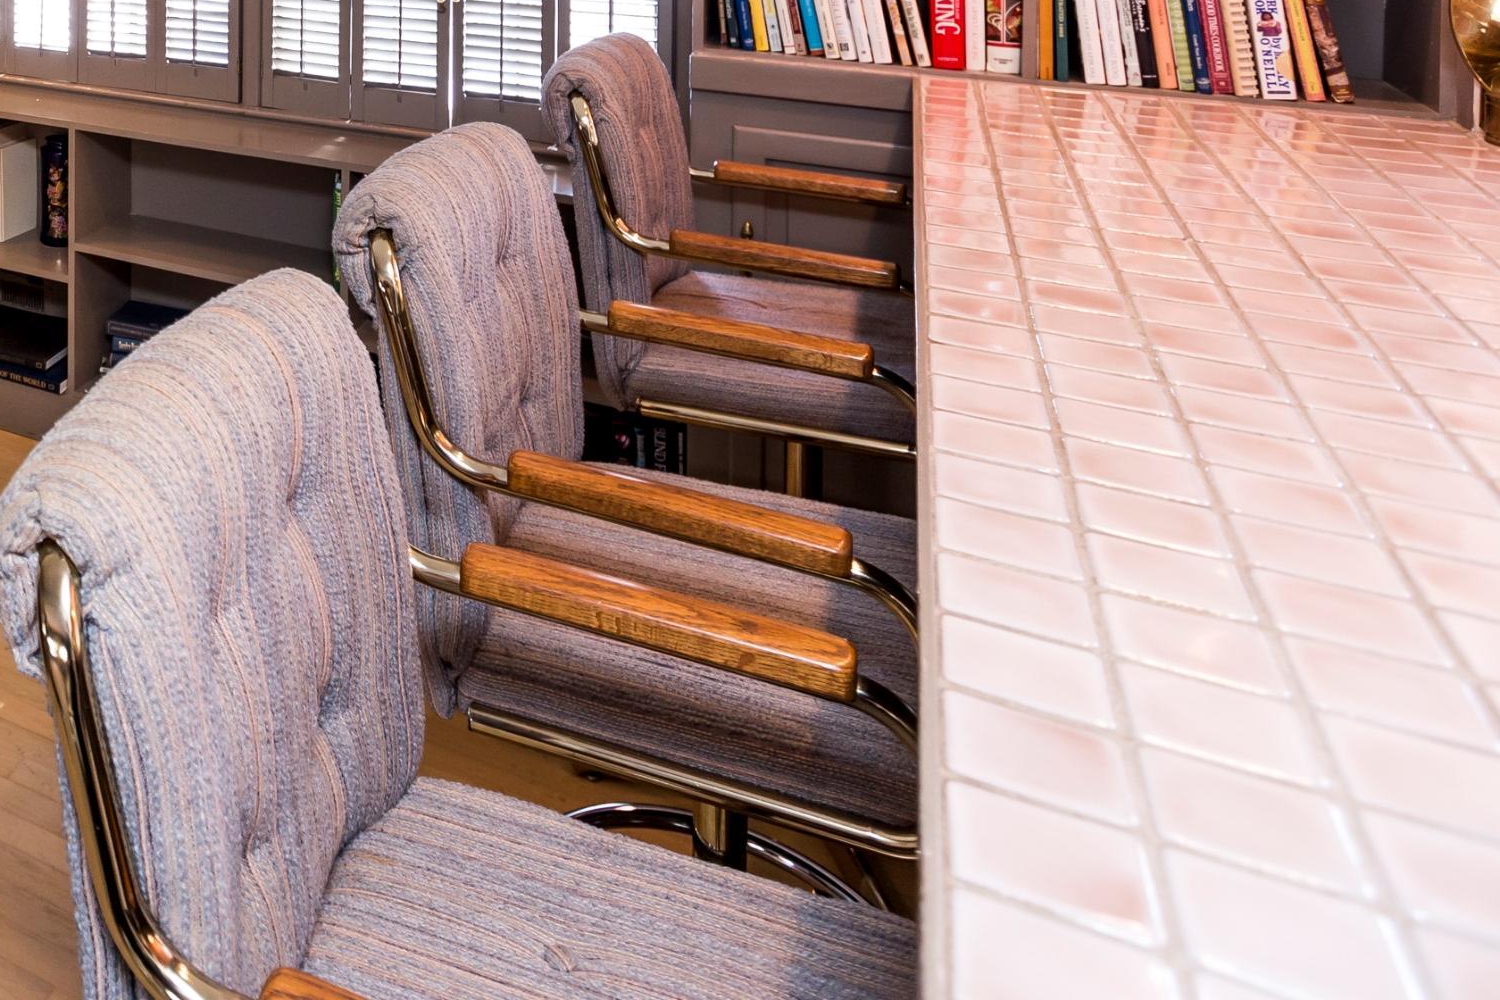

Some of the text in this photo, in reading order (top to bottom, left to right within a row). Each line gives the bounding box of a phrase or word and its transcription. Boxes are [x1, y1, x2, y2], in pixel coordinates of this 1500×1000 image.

[1135, 0, 1149, 32] Brennan's
[1207, 16, 1219, 36] TIMES
[1210, 36, 1225, 72] COOKBOOK
[1269, 37, 1283, 49] by
[9, 372, 22, 382] THE
[22, 376, 47, 388] WORLD
[653, 428, 667, 462] BLIND
